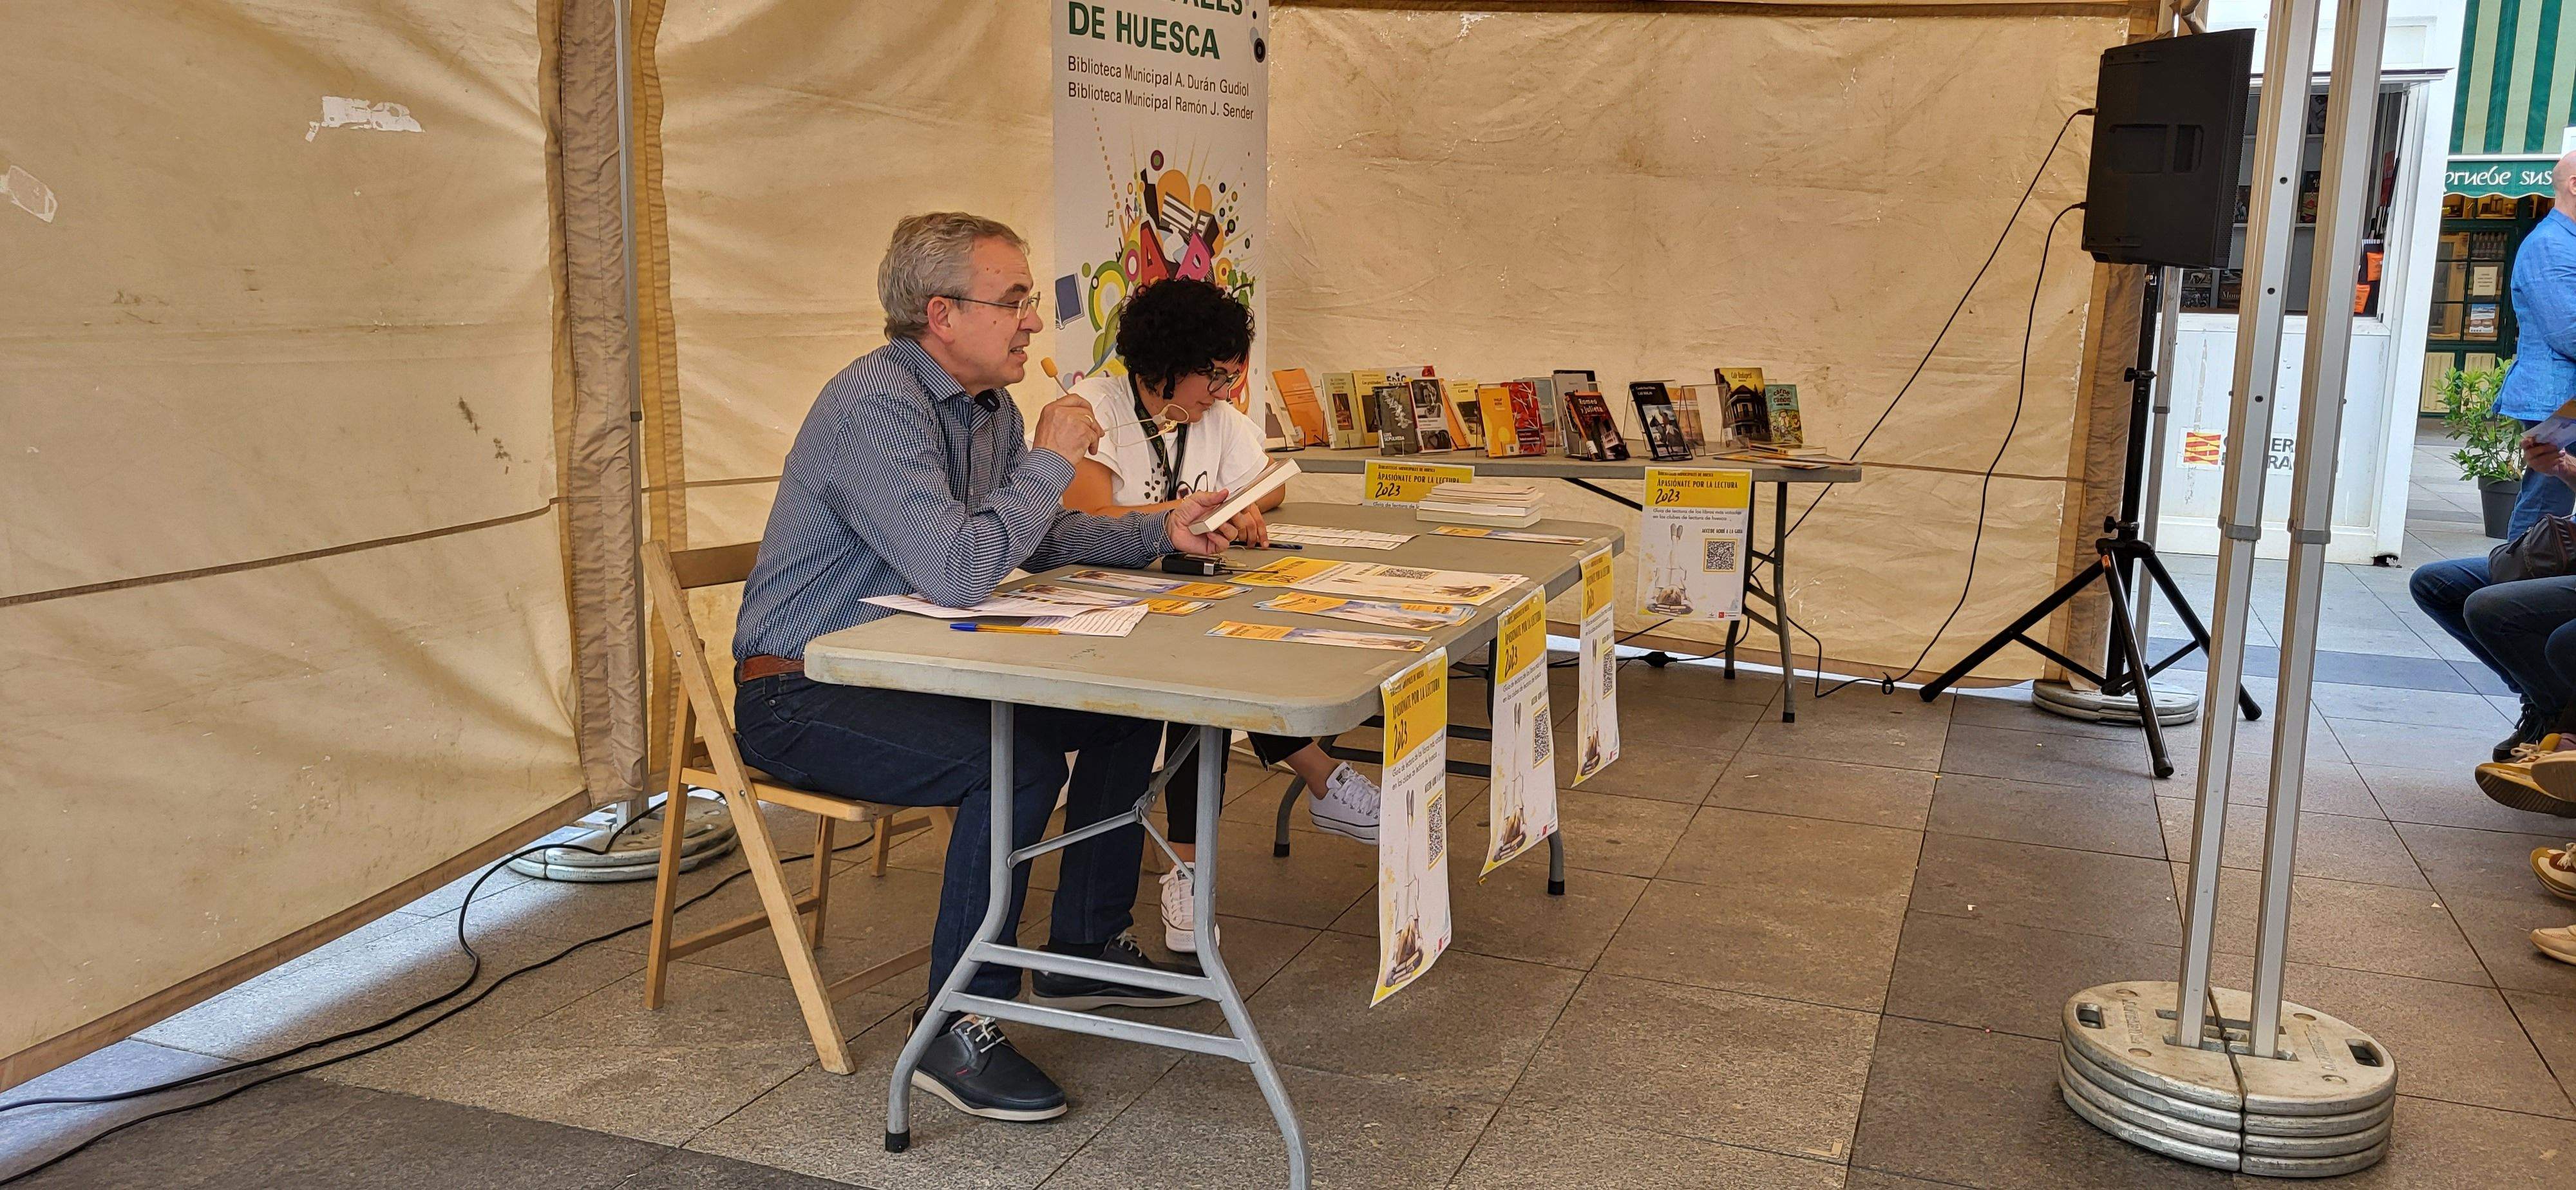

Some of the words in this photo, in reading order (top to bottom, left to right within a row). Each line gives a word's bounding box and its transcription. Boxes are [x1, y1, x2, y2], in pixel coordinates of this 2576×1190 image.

[1068, 1, 1106, 40] DE
[1116, 10, 1220, 60] HUESCA
[1068, 55, 1122, 78] Biblioteca
[1124, 64, 1172, 88] Municipal
[1175, 72, 1185, 88] A.
[1188, 74, 1216, 92] Durán
[1219, 79, 1249, 97] Gudiol
[1068, 82, 1122, 103] Biblioteca
[1124, 90, 1171, 111] Municipal
[1175, 97, 1208, 115] Ramón
[1211, 101, 1219, 116] J.
[1223, 103, 1254, 120] Sender
[2519, 170, 2553, 185] sus
[1375, 482, 1401, 498] 2023
[1655, 488, 1680, 504] 2023
[1393, 719, 1408, 760] 2023
